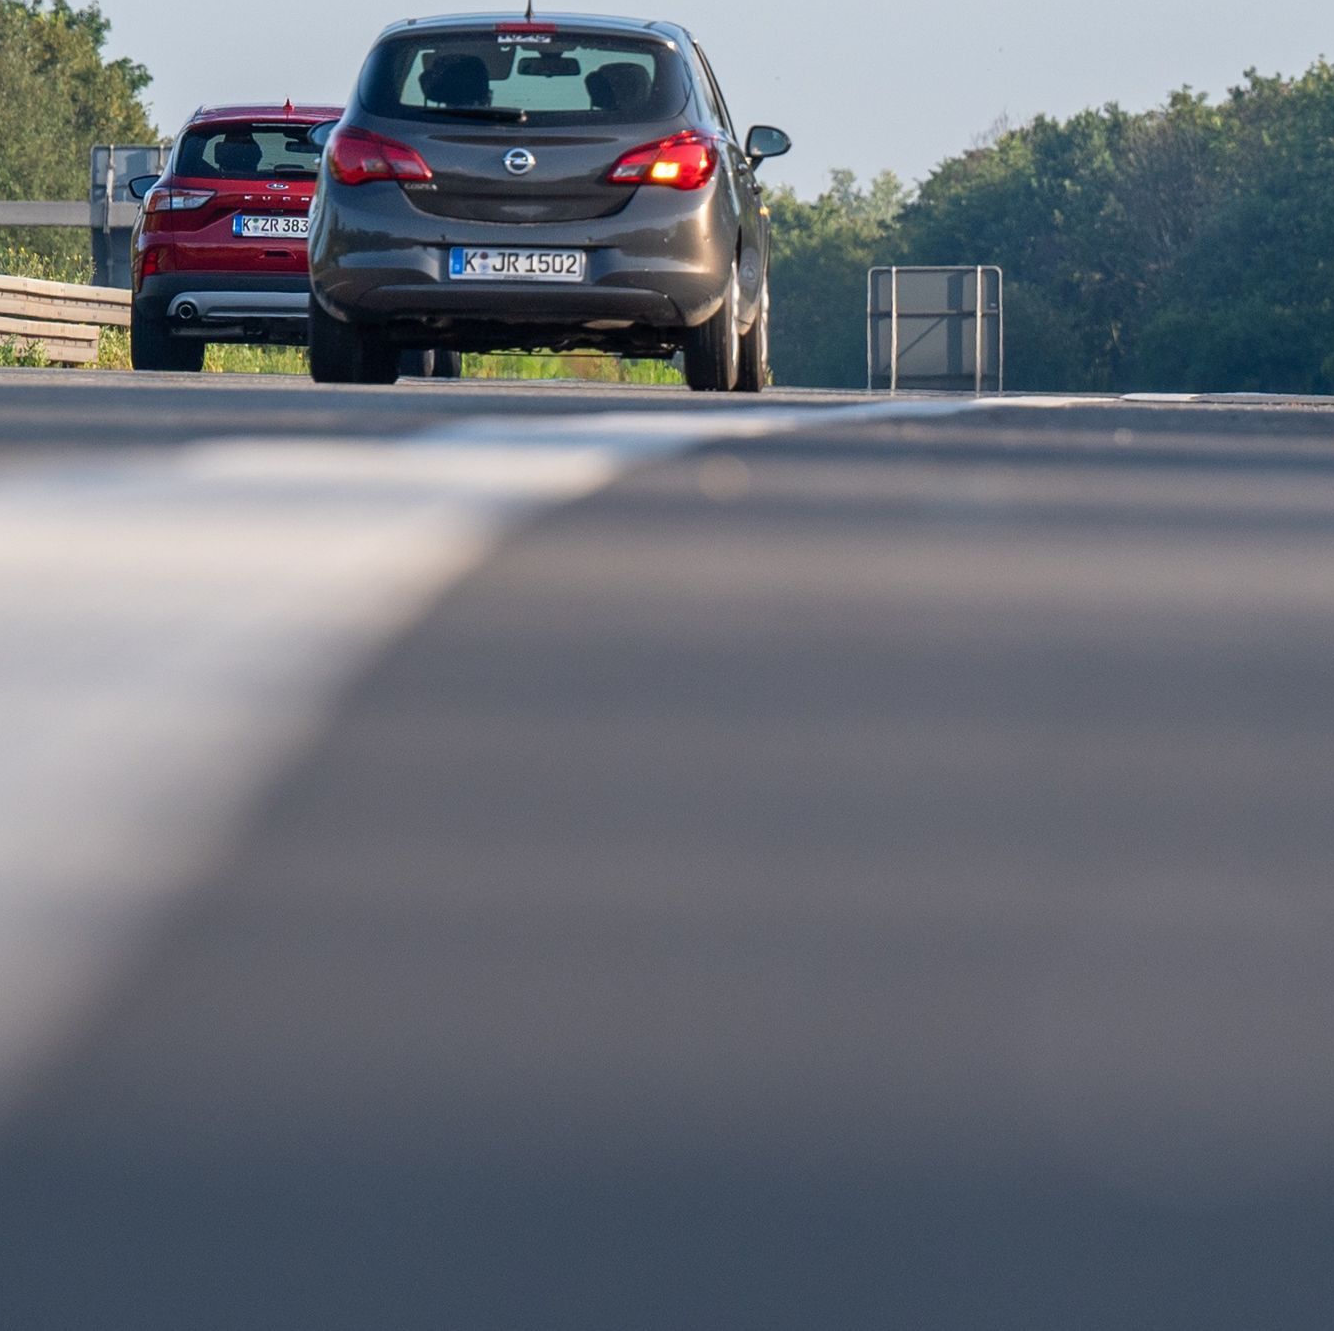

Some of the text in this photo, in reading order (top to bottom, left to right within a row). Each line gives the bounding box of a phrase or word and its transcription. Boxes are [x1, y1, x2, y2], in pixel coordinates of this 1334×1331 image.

[243, 218, 309, 233] K ZR 383
[464, 252, 577, 274] K JR 1502
